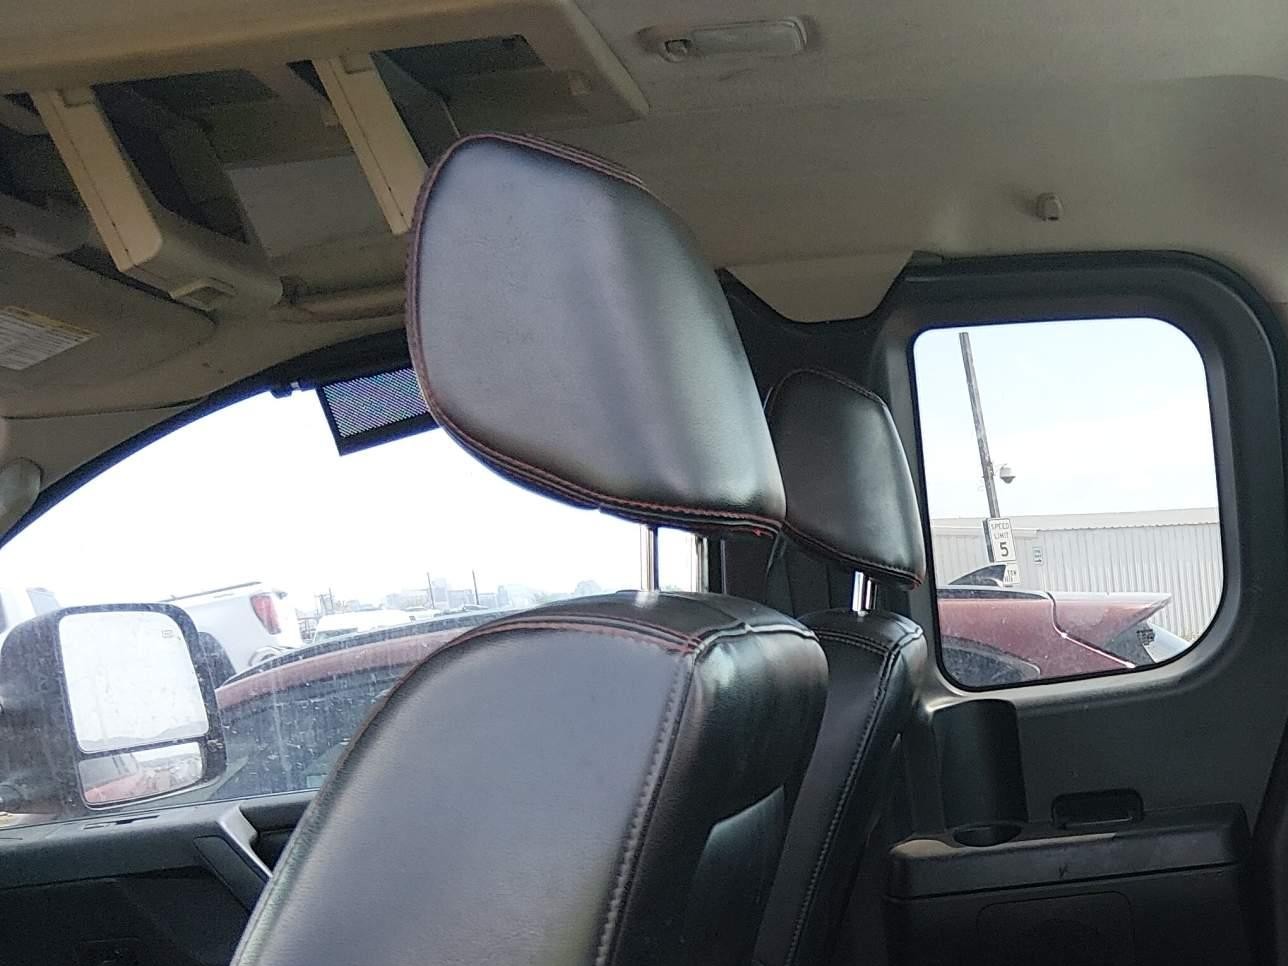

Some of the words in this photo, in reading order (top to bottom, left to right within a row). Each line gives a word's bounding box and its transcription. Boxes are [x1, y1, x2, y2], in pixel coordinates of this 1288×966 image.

[991, 522, 1010, 530] SPEED
[993, 531, 1009, 540] LIMIT
[999, 541, 1009, 557] 5
